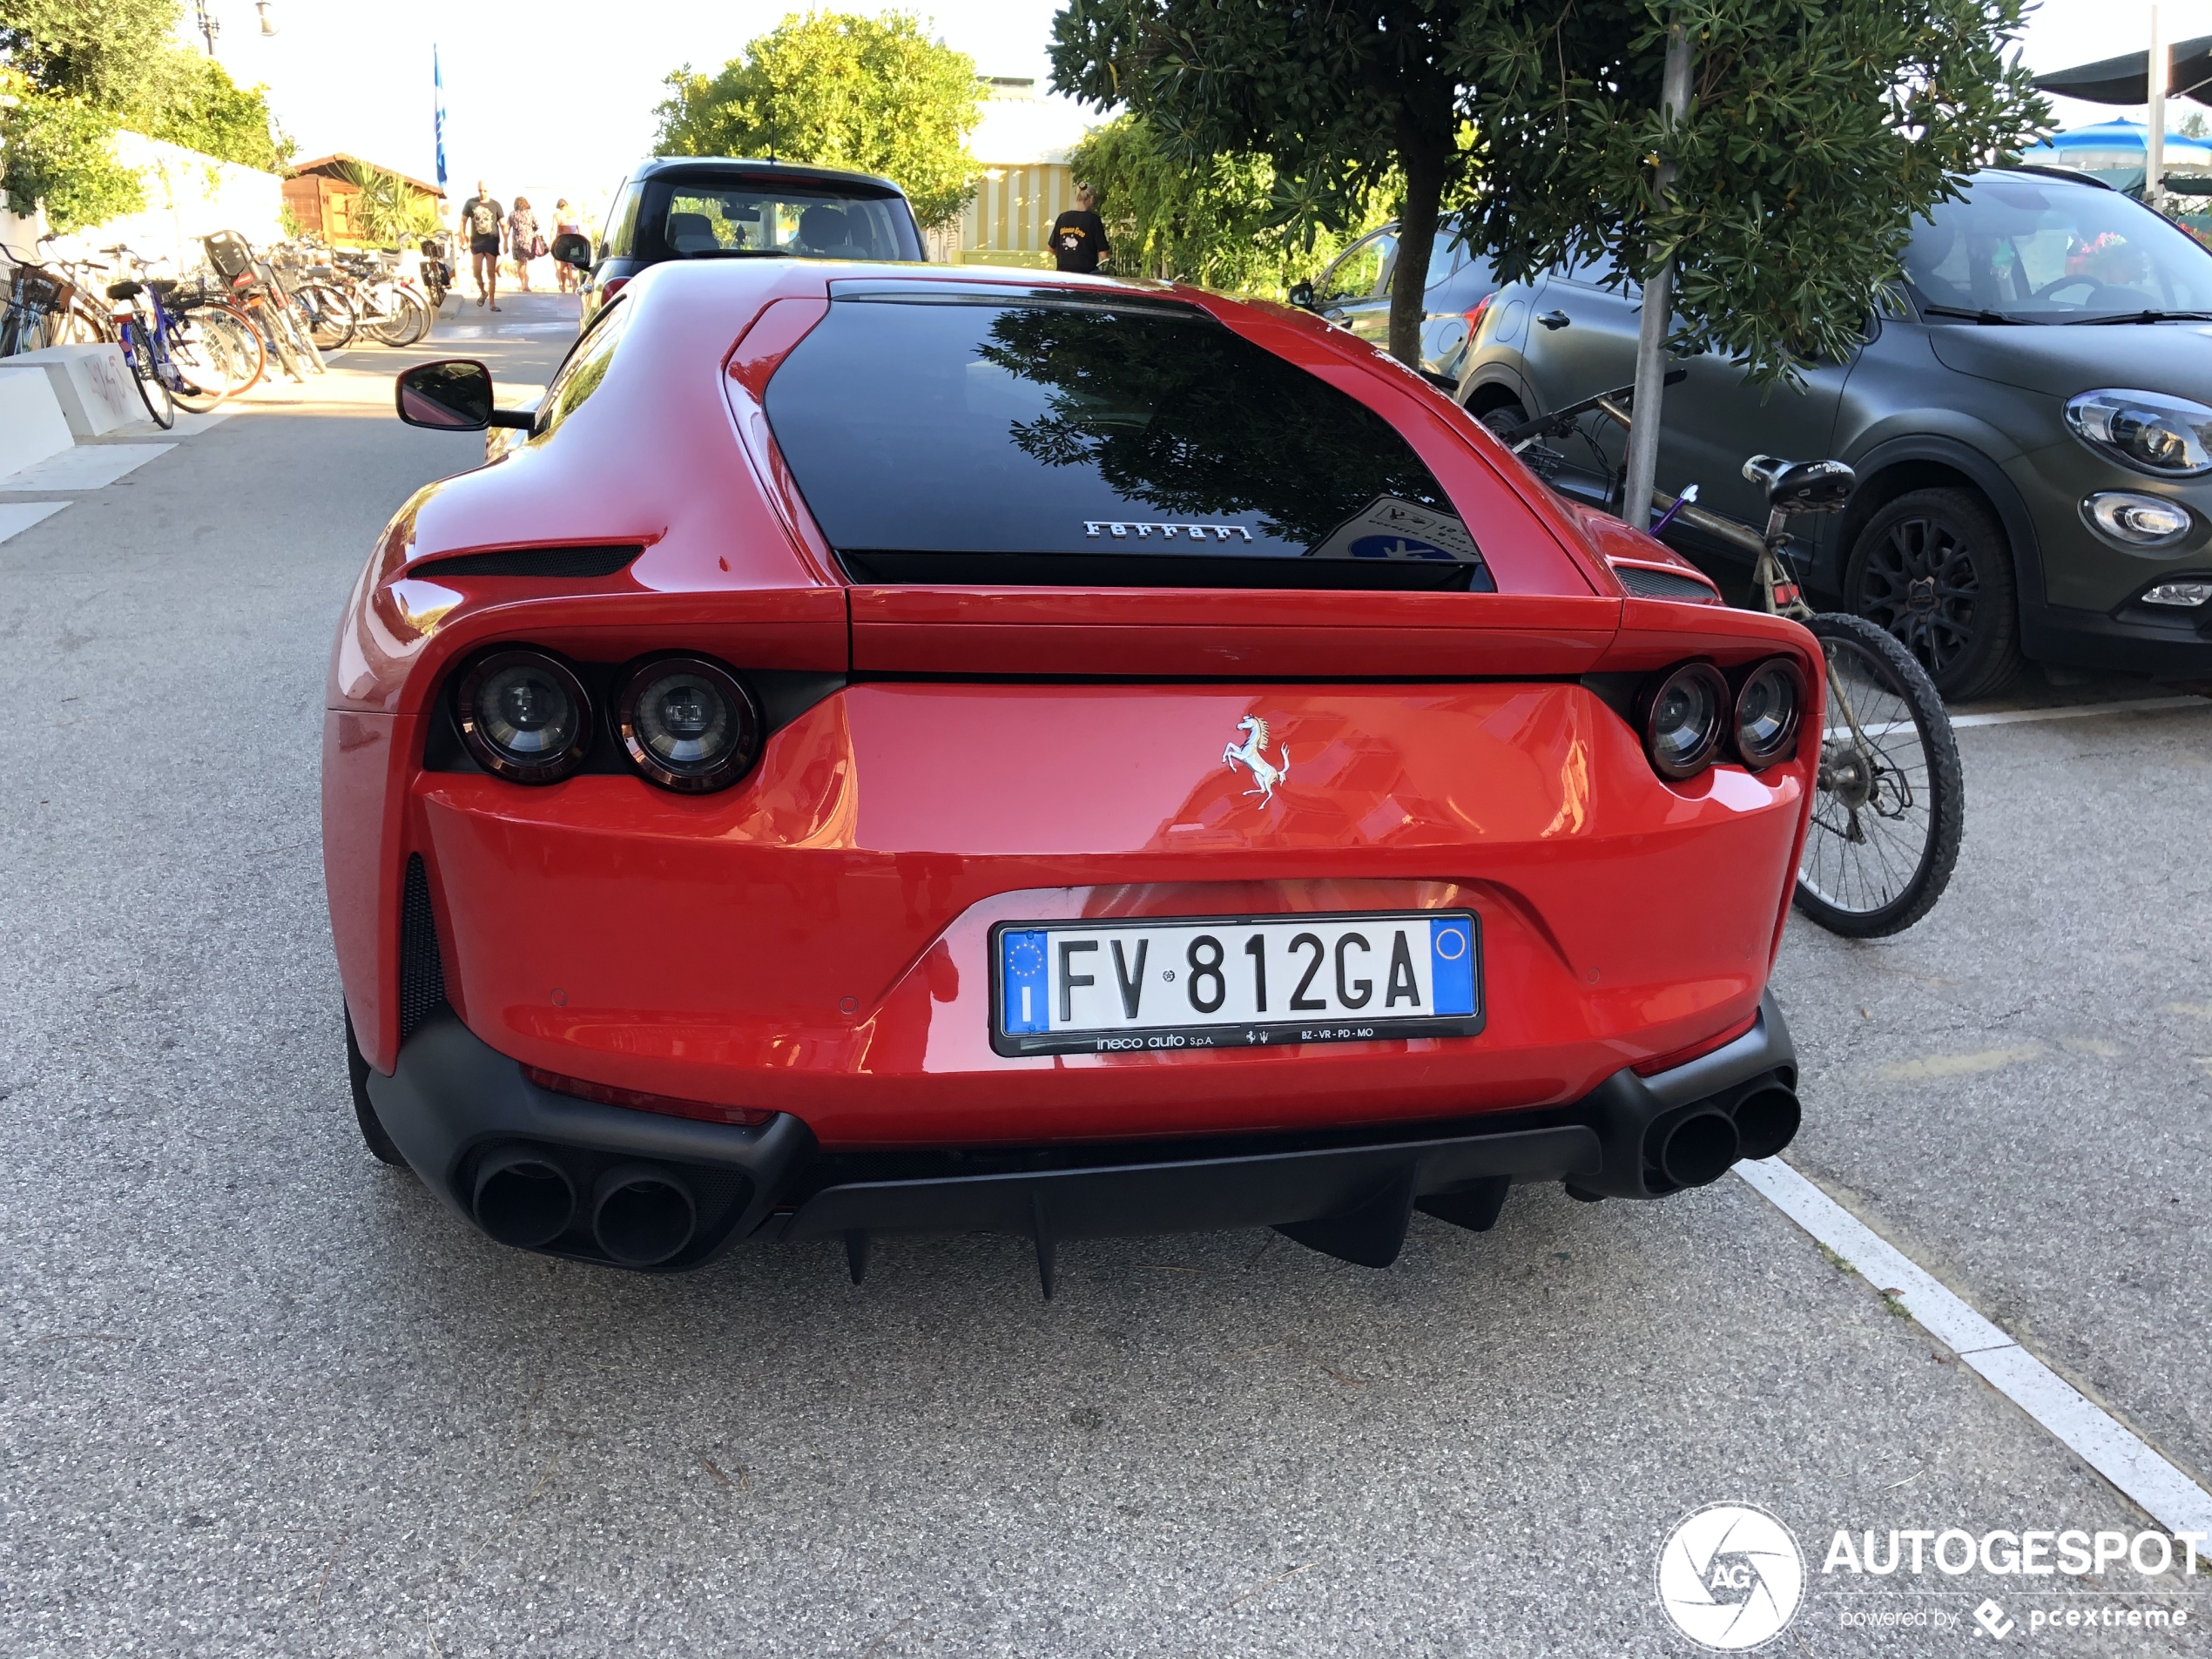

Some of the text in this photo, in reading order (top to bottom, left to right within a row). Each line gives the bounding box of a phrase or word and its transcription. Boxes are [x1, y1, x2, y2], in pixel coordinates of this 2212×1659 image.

[1083, 521, 1252, 540] Ferrari
[1057, 938, 1149, 1022] FV
[1185, 929, 1421, 1015] 812GA
[1096, 1036, 1143, 1050] ineco
[1148, 1033, 1185, 1048] auto
